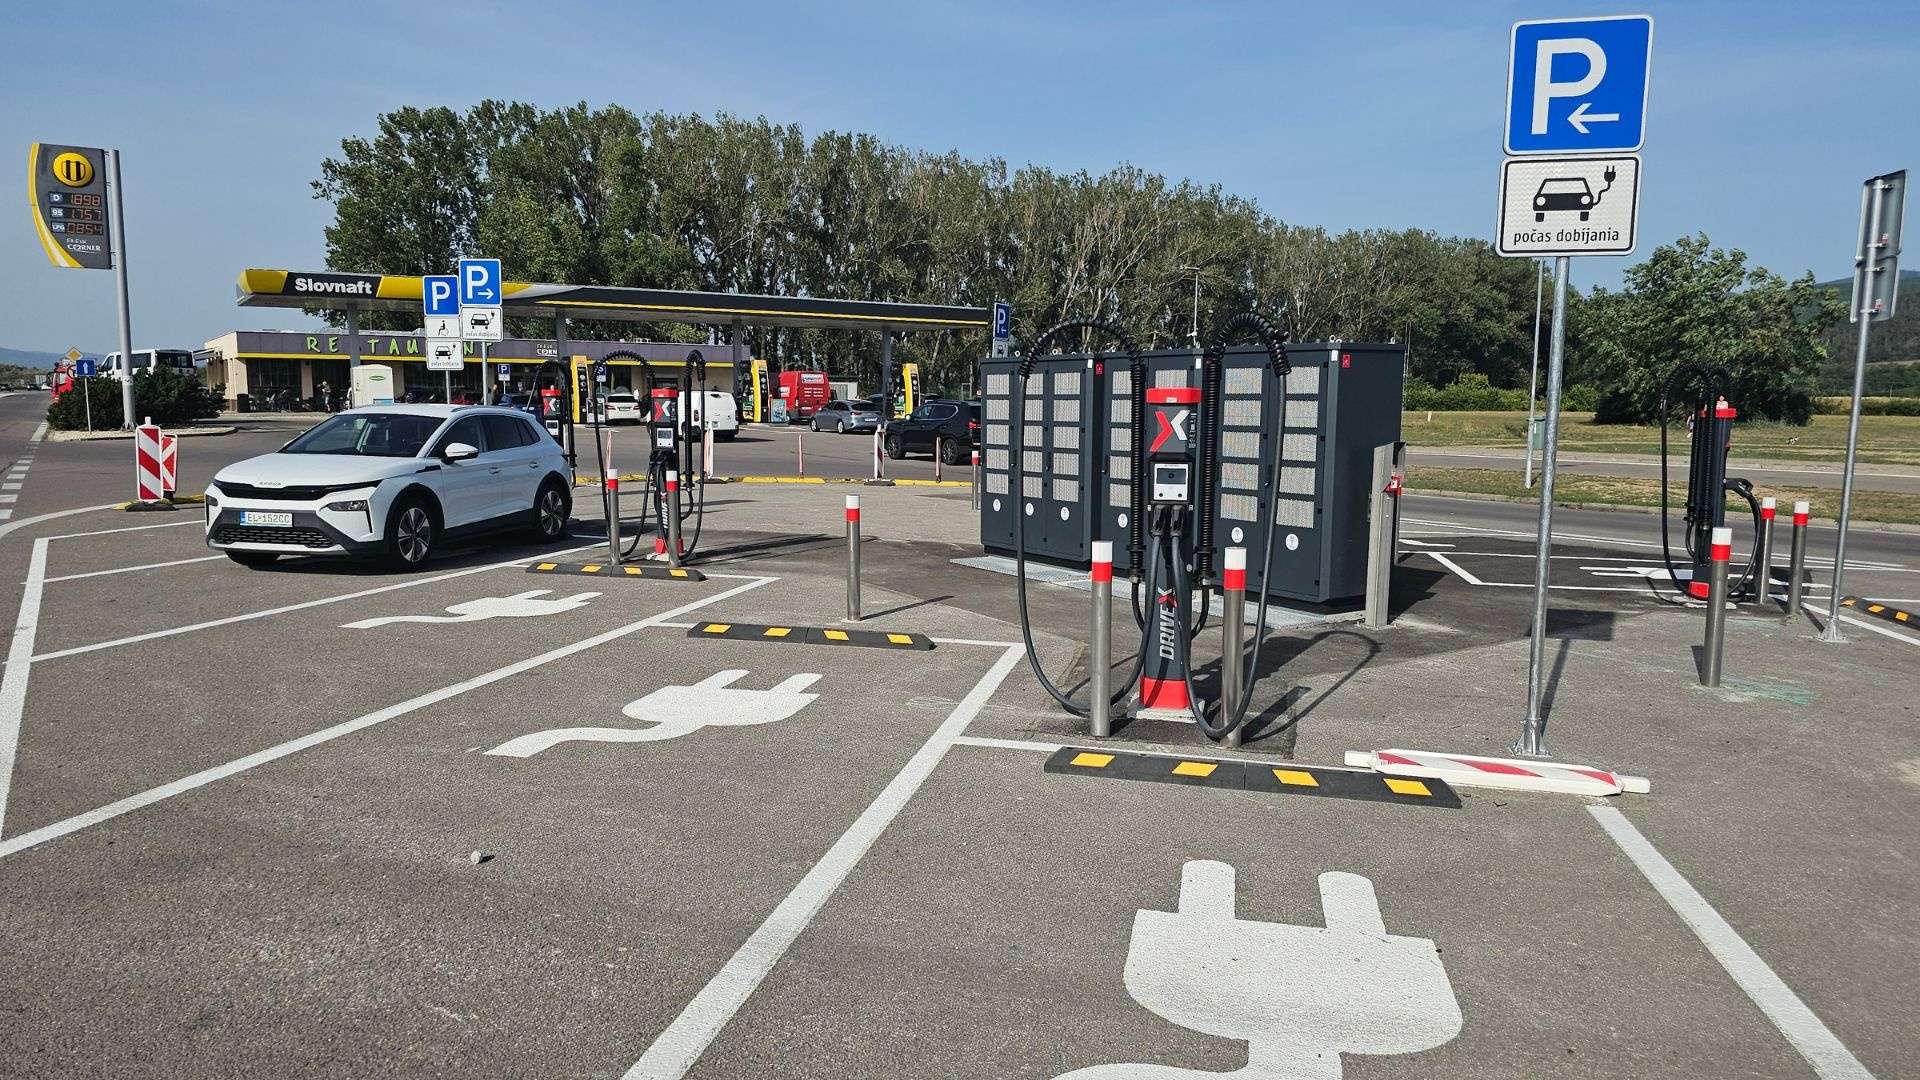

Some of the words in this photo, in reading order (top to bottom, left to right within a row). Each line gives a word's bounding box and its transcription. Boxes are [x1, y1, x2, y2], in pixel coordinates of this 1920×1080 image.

[1531, 37, 1607, 135] P
[1513, 229, 1551, 246] počas
[1556, 227, 1619, 244] dobíjania
[294, 277, 372, 295] Slovnaft
[466, 265, 489, 299] P
[431, 281, 451, 311] P
[997, 308, 1006, 334] P
[536, 348, 557, 356] CORN
